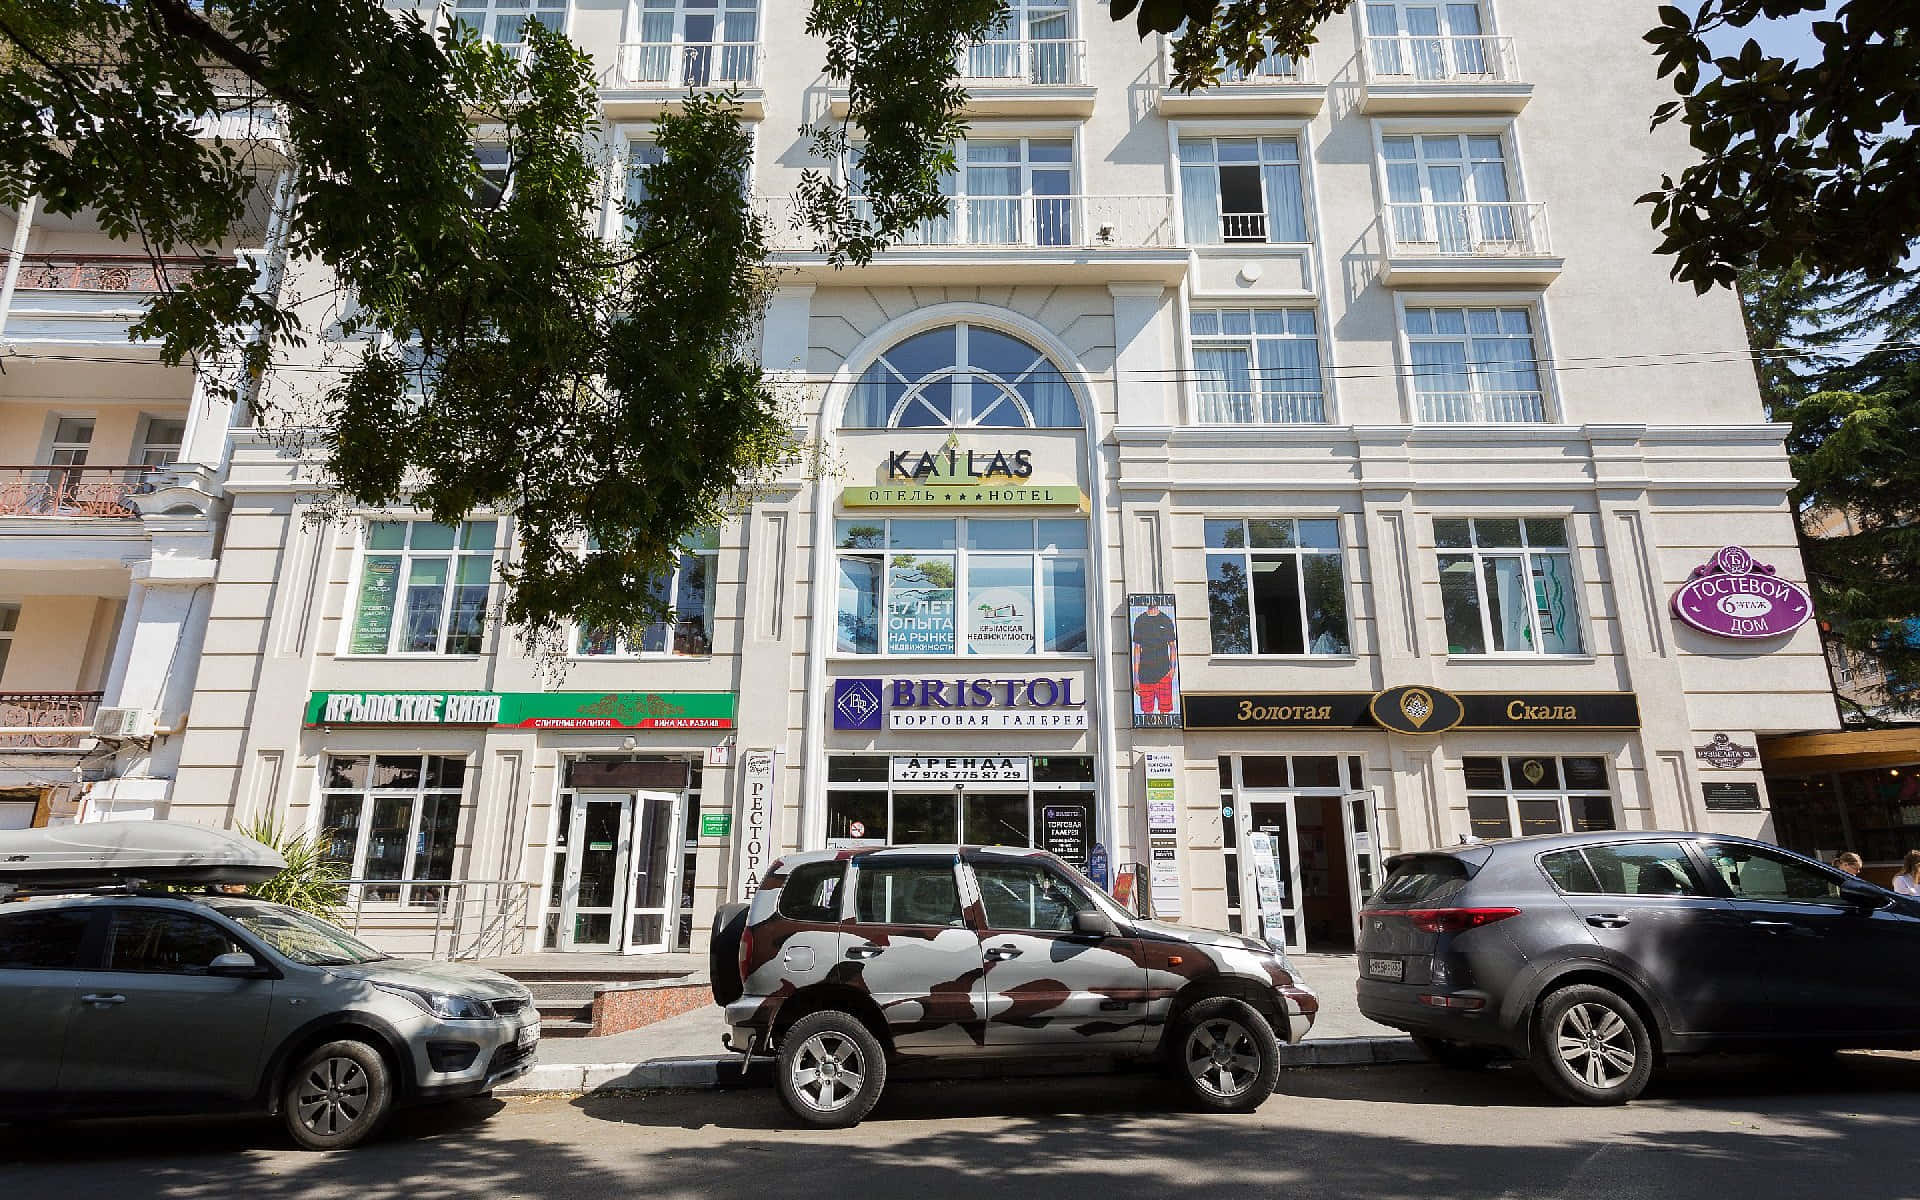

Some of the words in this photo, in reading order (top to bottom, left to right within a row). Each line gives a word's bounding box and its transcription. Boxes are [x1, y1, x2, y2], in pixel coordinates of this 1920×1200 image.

[889, 449, 1033, 479] KAILAS
[869, 490, 935, 501] ОТЕЛЬ
[989, 490, 1054, 501] HOTEL
[1690, 577, 1792, 602] ГОСТЕВОЙ
[889, 600, 910, 615] 17
[914, 600, 953, 615] ЛЕТ
[1722, 596, 1737, 614] 6
[889, 617, 954, 630] ОПЫТА
[980, 624, 1023, 633] КРЫМСКАЯ
[1730, 618, 1769, 635] ДОМ
[889, 632, 907, 642] НА
[909, 632, 955, 642] РЫНКЕ
[967, 633, 1035, 641] НЕДВИЖИМОСТЬ
[890, 677, 1087, 708] BRISTOL
[324, 694, 443, 723] КРЫМСКИЕ
[443, 694, 503, 723] ВИНА
[1236, 700, 1332, 721] Золотая
[1506, 699, 1577, 721] Скала
[535, 719, 575, 727] СПИРТНЫЕ
[576, 719, 611, 727] НАПИТКИ
[654, 719, 676, 727] ВИНА
[689, 719, 719, 727] РАЗЛИВ
[893, 715, 989, 726] ТОРГОВАЯ
[1003, 715, 1085, 726] ГАЛЕРЕЯ
[907, 758, 1014, 770] АРЕНДА
[901, 771, 919, 779] +7
[922, 771, 949, 779] 978
[952, 771, 978, 779] 775
[981, 771, 999, 779] 87
[1003, 771, 1021, 779] 29
[743, 782, 764, 900] РЕСТОРАН
